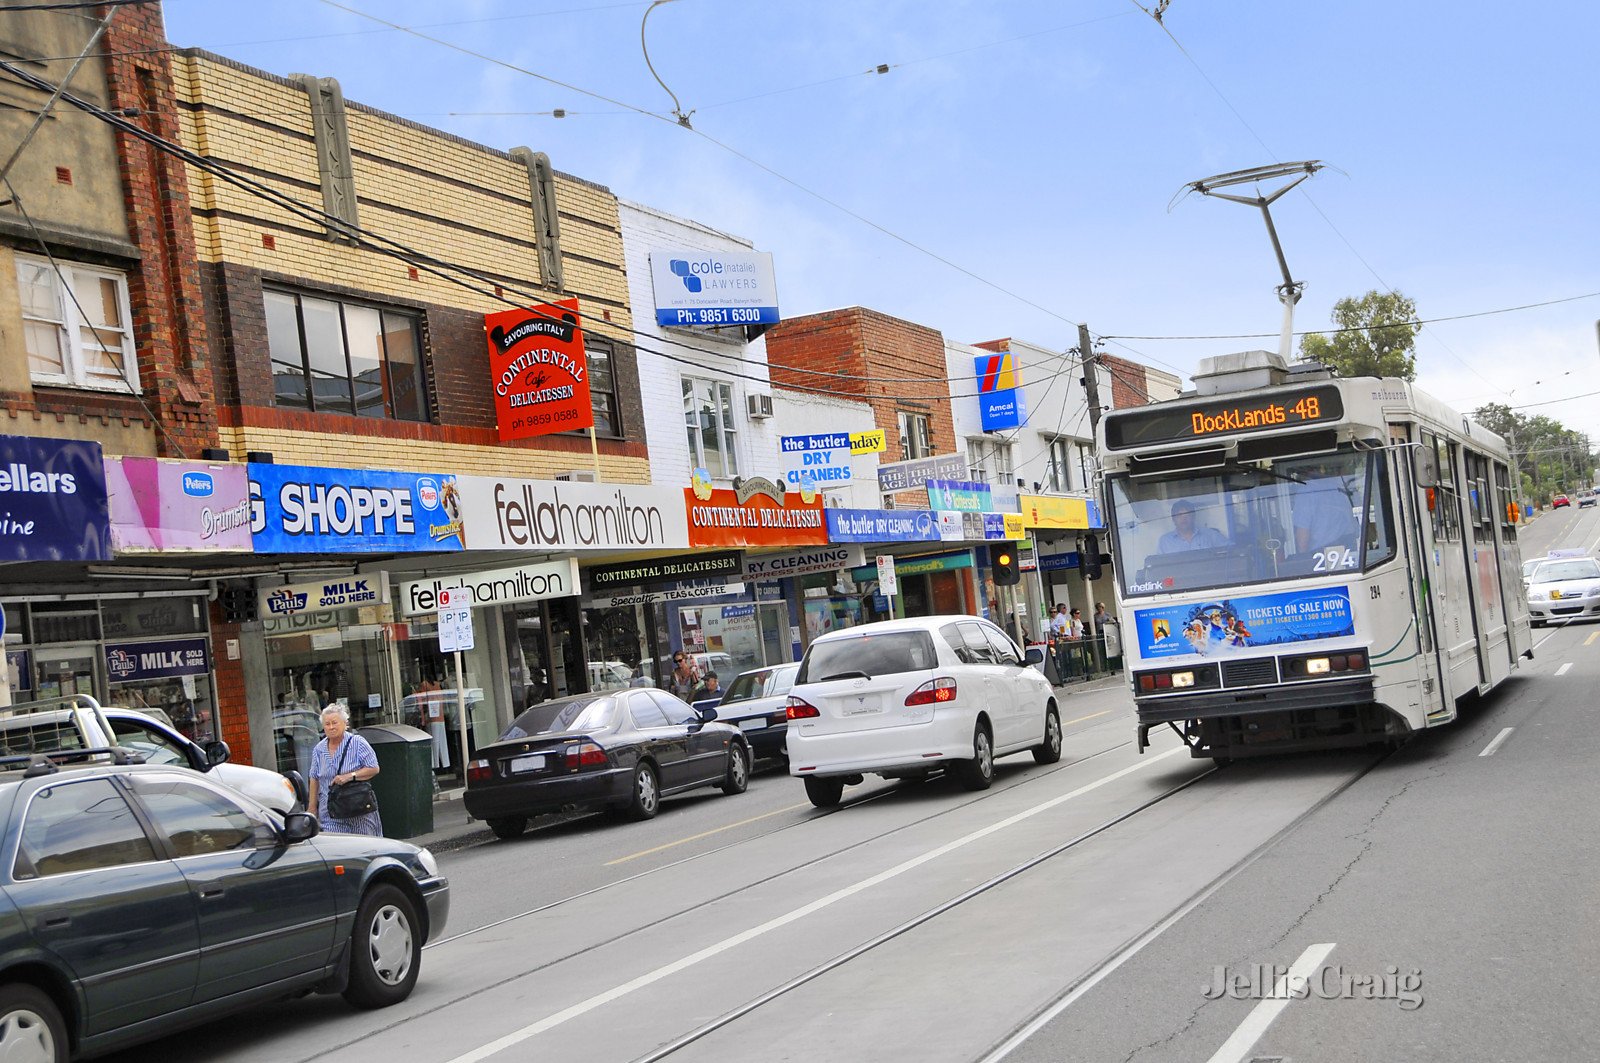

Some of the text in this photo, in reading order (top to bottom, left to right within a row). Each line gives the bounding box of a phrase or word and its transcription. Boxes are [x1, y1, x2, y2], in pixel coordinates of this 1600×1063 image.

[692, 259, 756, 274] cole (natalie)
[705, 279, 757, 289] LAWYERS
[678, 308, 760, 323] Ph: 9851 6300
[504, 323, 565, 347] SAVOURING ITALY
[496, 349, 585, 397] CONTINENTAL
[524, 370, 552, 389] Cafe
[510, 385, 574, 408] DELICATESSEN
[1371, 388, 1408, 401] melbourne
[989, 402, 1014, 412] Amcal
[512, 409, 579, 430] ph 9859 0588
[784, 435, 847, 451] the butler
[802, 451, 832, 466] DRY
[908, 467, 935, 478] THE
[938, 463, 963, 473] THE
[0, 463, 77, 494] ellars
[184, 477, 212, 491] Peters
[880, 472, 906, 483] THE
[881, 481, 907, 490] AGE
[421, 489, 437, 500] Peters
[742, 480, 766, 498] SAVOURING
[250, 480, 415, 536] G SHOPPE
[494, 483, 665, 546] fellahamilton
[0, 512, 35, 535] ine
[692, 506, 822, 528] CONTINENTAL DELICATESSEN
[837, 514, 914, 535] the butler DRY CLEANING
[747, 549, 849, 573] RY CLEANING
[1040, 556, 1069, 568] Amcal
[1312, 550, 1355, 572] 294
[596, 558, 736, 583] CONTINENTAL DELICATESSEN
[741, 560, 848, 580] EXPRESS SERVICE
[323, 580, 369, 596] MILK
[409, 570, 563, 611] felhamilton
[663, 591, 688, 600] TEAS
[694, 586, 726, 597] COFFEE
[1129, 580, 1163, 592] metlink
[1369, 584, 1381, 600] 294
[272, 597, 304, 611] Pauls
[319, 591, 376, 607] SOLD HERE
[1247, 598, 1344, 619] TICKETS ON SALE NOW
[1248, 618, 1264, 626] BOOK
[1266, 617, 1273, 625] AT
[1275, 615, 1303, 624] TICKETEK
[1304, 613, 1319, 621] 1300
[1334, 609, 1346, 618] 104
[111, 651, 184, 671] Pauls MILK
[186, 649, 203, 659] SOLD
[186, 658, 204, 667] HERE
